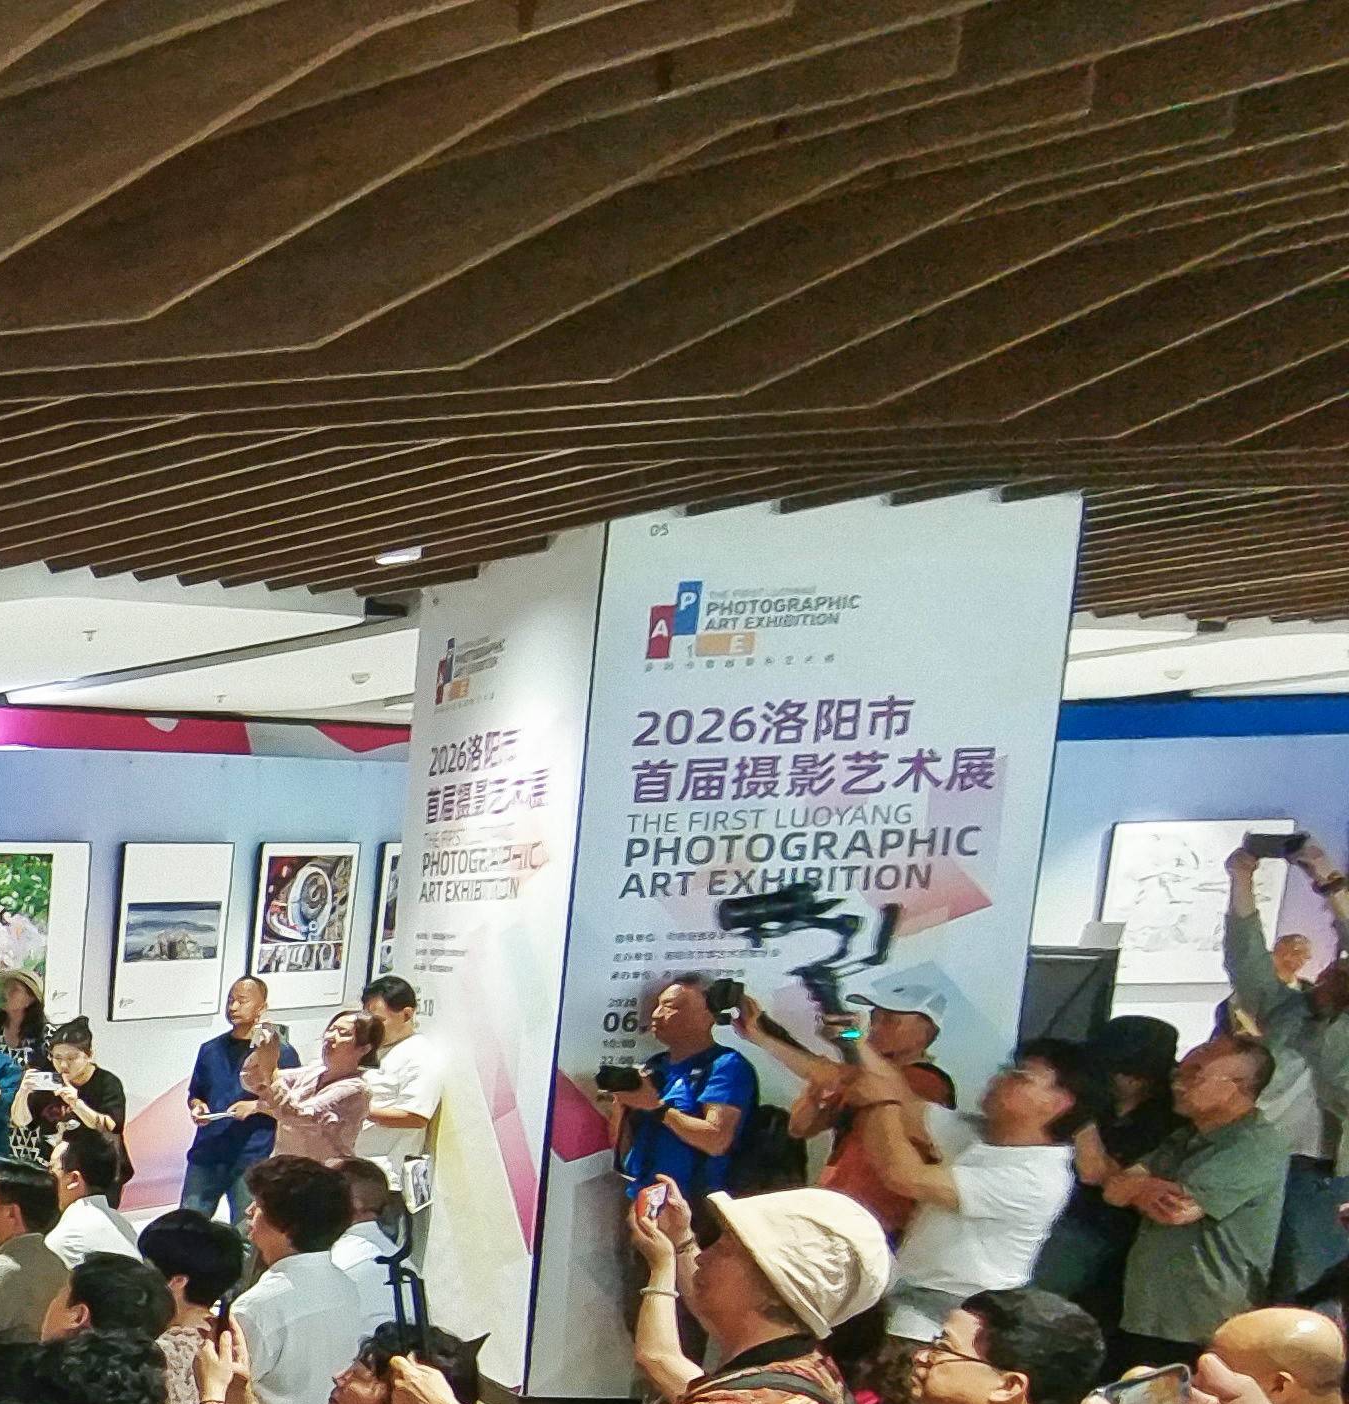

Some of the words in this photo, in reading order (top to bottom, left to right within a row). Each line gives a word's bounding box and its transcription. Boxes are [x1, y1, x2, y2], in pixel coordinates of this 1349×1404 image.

[679, 591, 698, 611] P
[706, 594, 862, 616] PHOTOGRAPHIC
[651, 618, 669, 639] A
[705, 616, 740, 631] ART
[744, 612, 841, 630] EXHIBITION
[729, 635, 747, 653] E
[632, 694, 916, 747] 2026洛阳市
[632, 746, 998, 804] 首届摄影艺术展
[627, 811, 678, 833] THE
[688, 807, 765, 830] FIRST
[775, 803, 913, 828] LUOYANG
[624, 825, 983, 867] PHOTOGRAPHIC
[618, 870, 695, 899] ART
[708, 863, 933, 898] EXHIBITION
